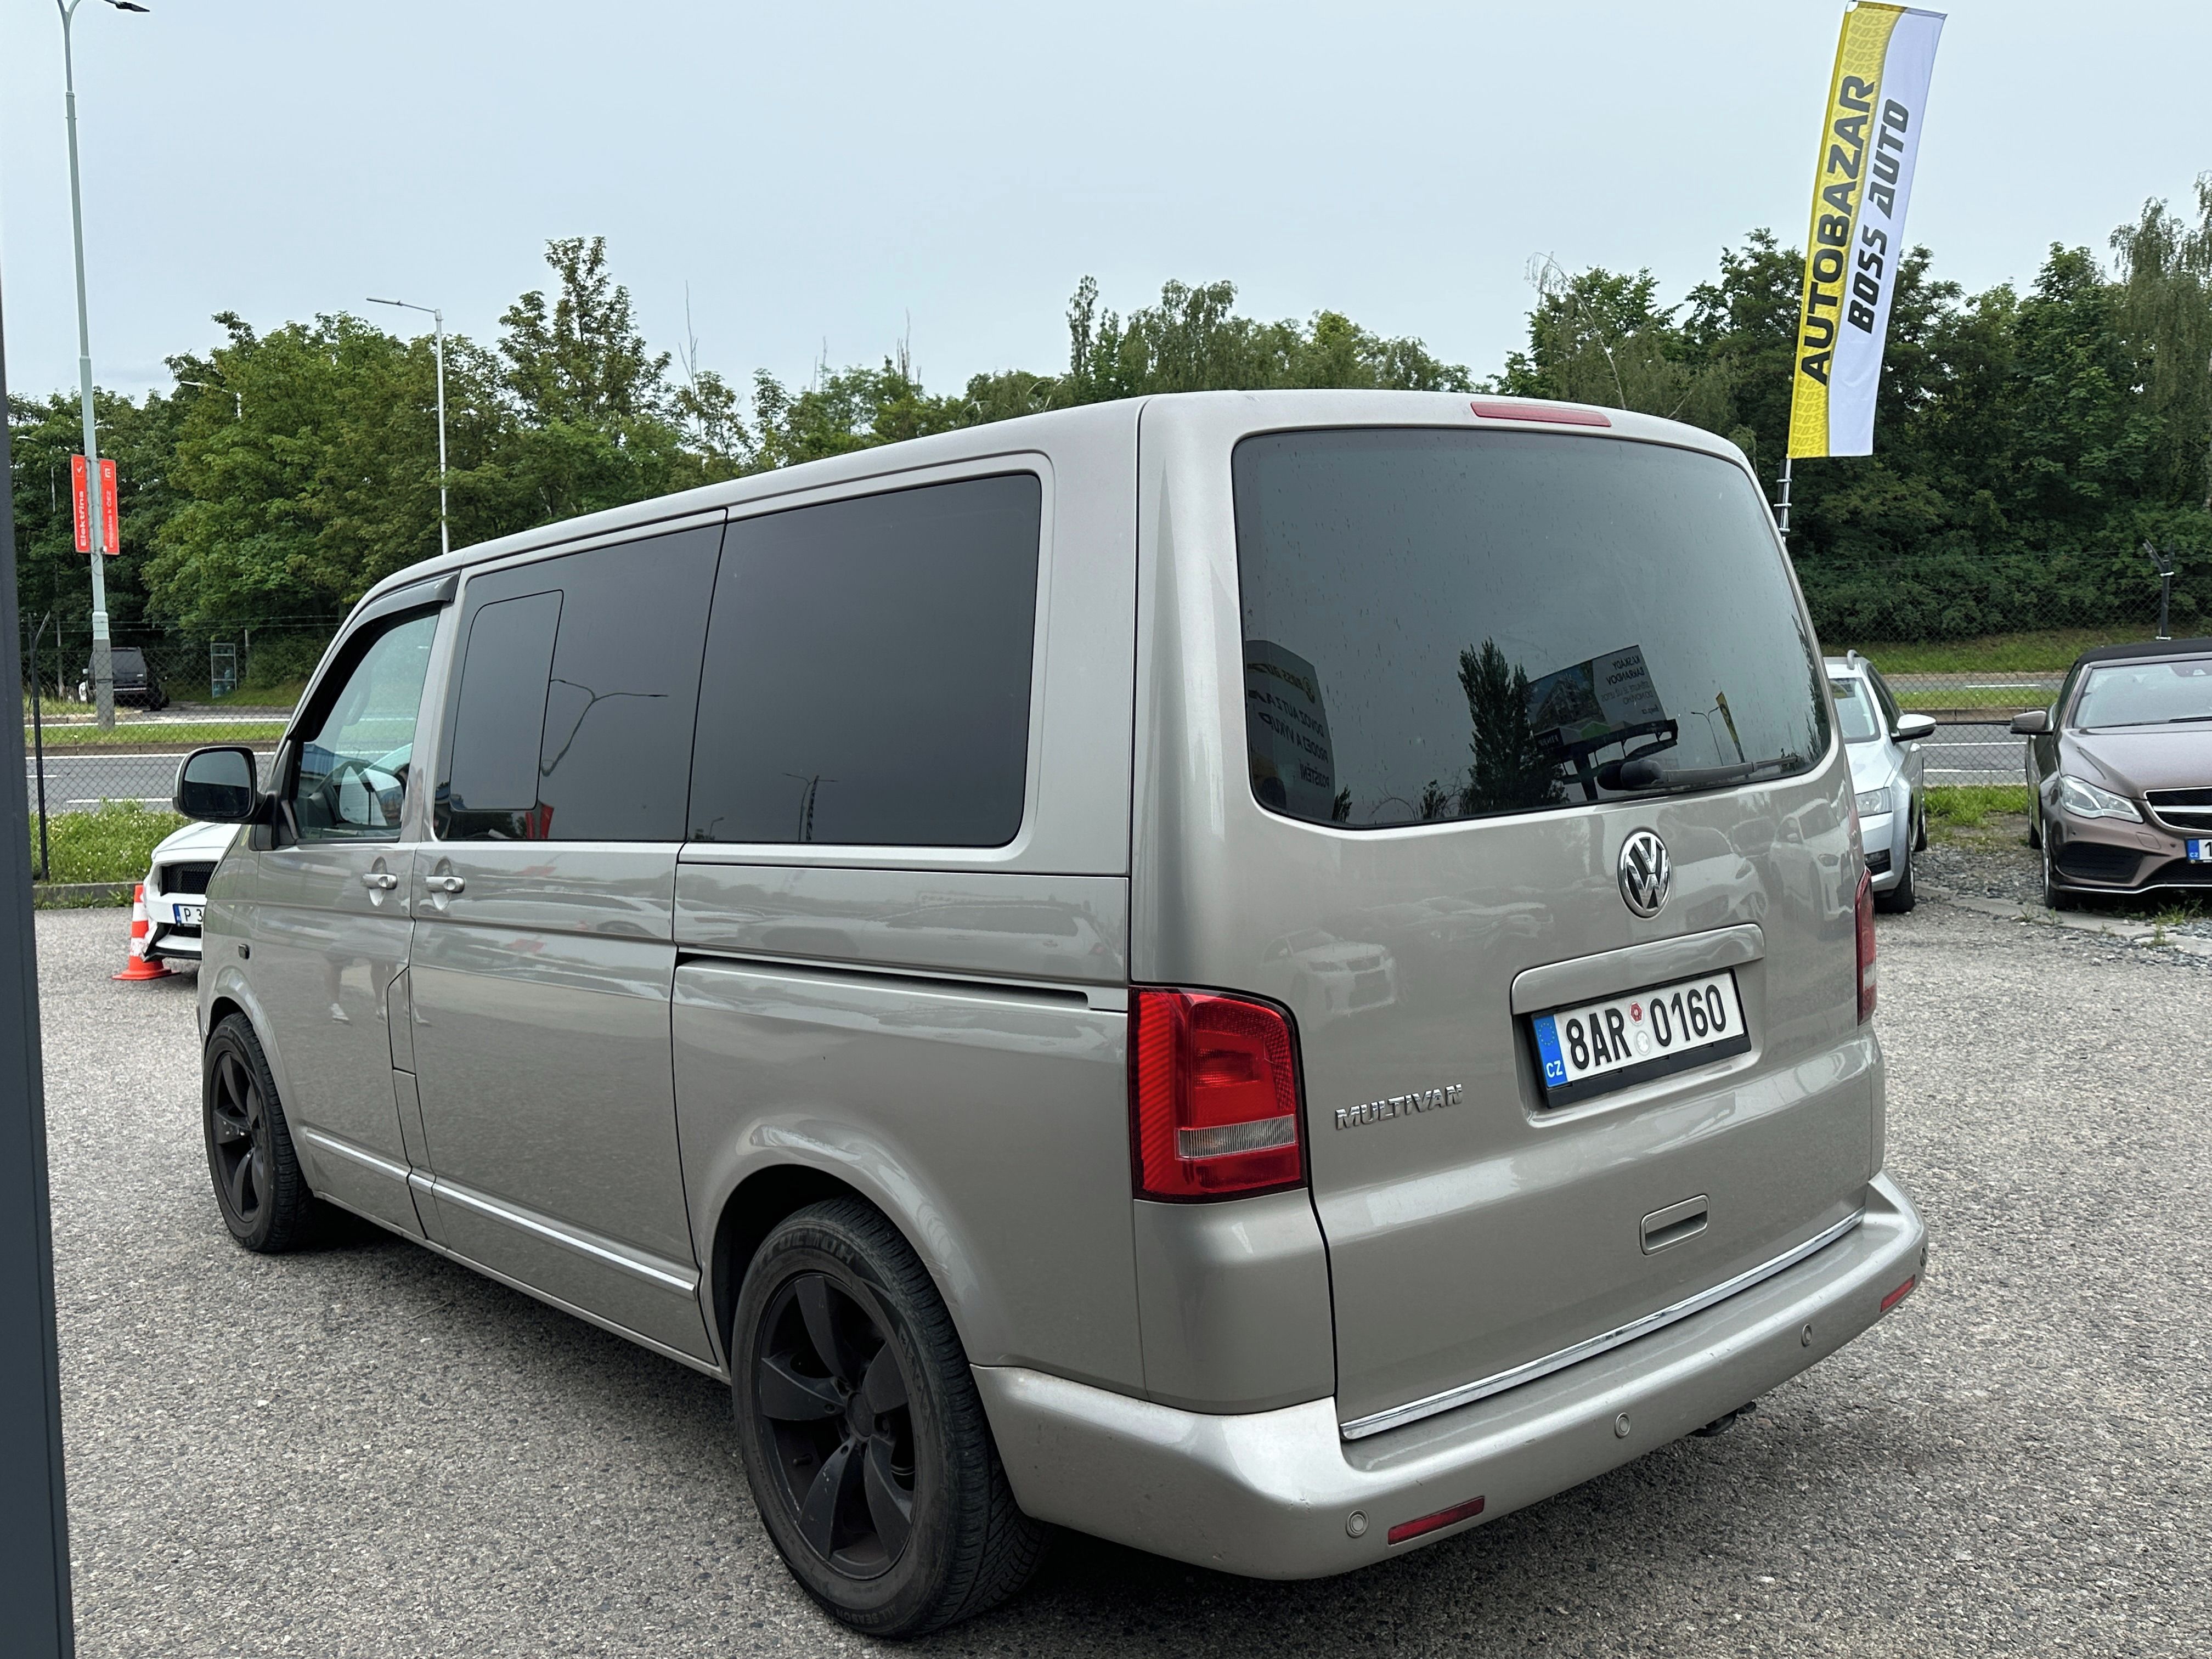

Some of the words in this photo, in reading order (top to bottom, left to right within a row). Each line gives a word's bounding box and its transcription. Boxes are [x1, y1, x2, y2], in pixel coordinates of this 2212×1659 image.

[1801, 76, 1875, 386] AUTOBAZAR
[1847, 224, 1887, 334] BOSS
[1868, 99, 1909, 219] AUTO
[1566, 1008, 1632, 1070] 8AR
[1650, 984, 1726, 1047] 0160
[1545, 1059, 1564, 1079] CZ
[1335, 1084, 1462, 1130] MULTIVAN
[836, 1608, 879, 1624] SEASON
[879, 1604, 897, 1621] ALL
